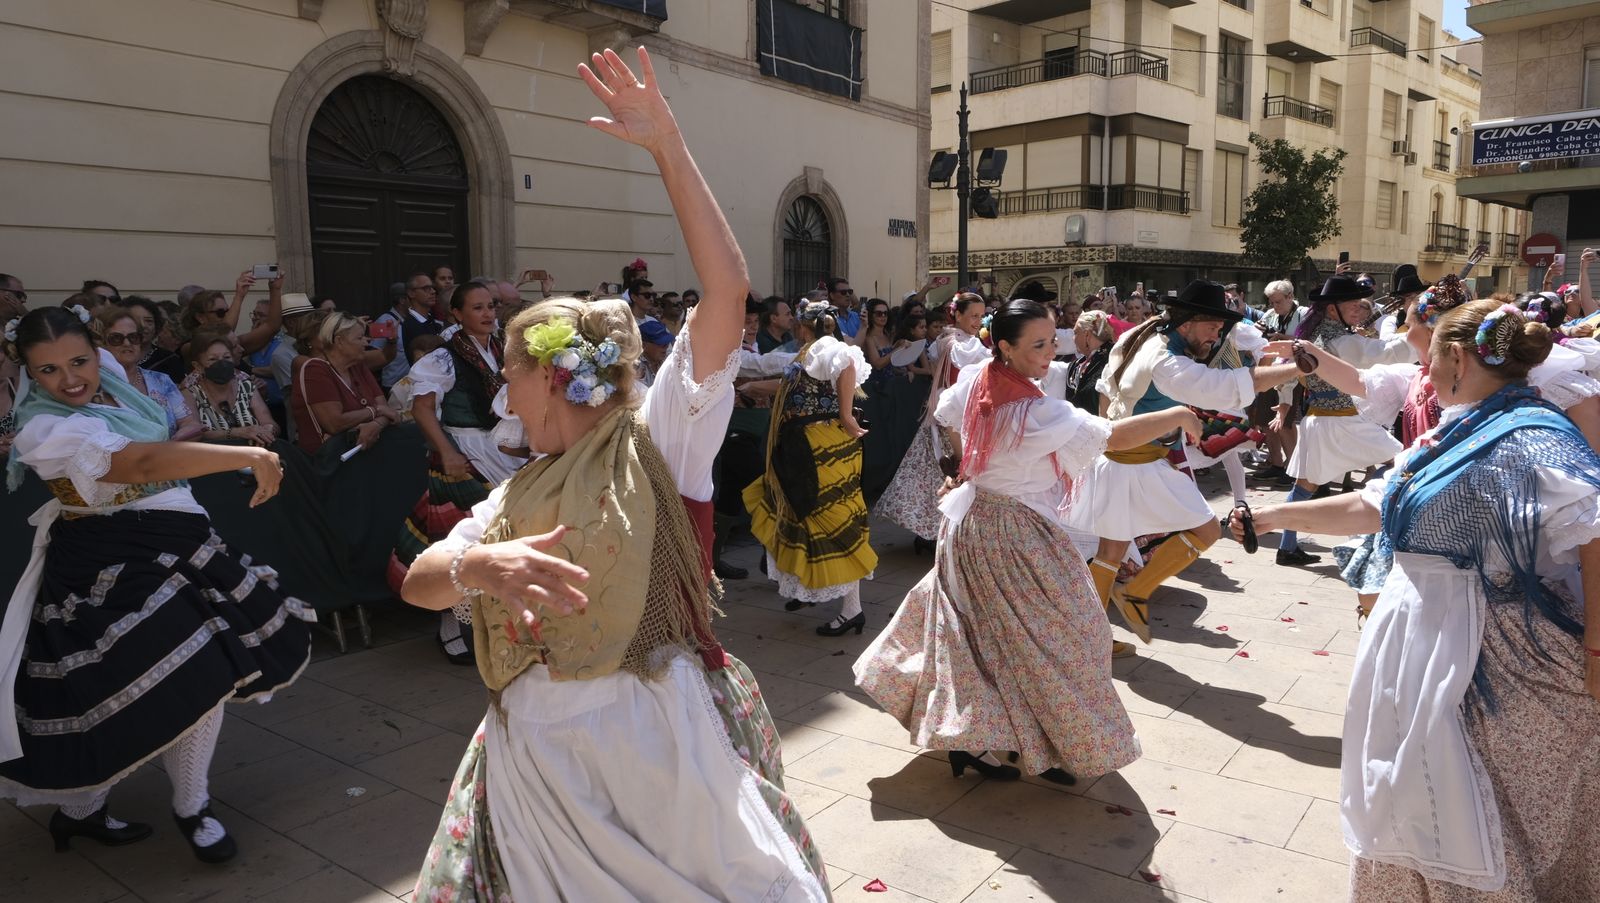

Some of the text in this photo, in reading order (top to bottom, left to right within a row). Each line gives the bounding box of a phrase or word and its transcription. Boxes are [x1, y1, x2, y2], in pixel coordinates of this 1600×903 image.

[1480, 123, 1553, 140] CLINICA
[1505, 138, 1551, 148] Francisco
[1556, 135, 1581, 143] Caba
[1504, 146, 1551, 156] Alejandro
[1476, 154, 1534, 164] ORTODONCIA
